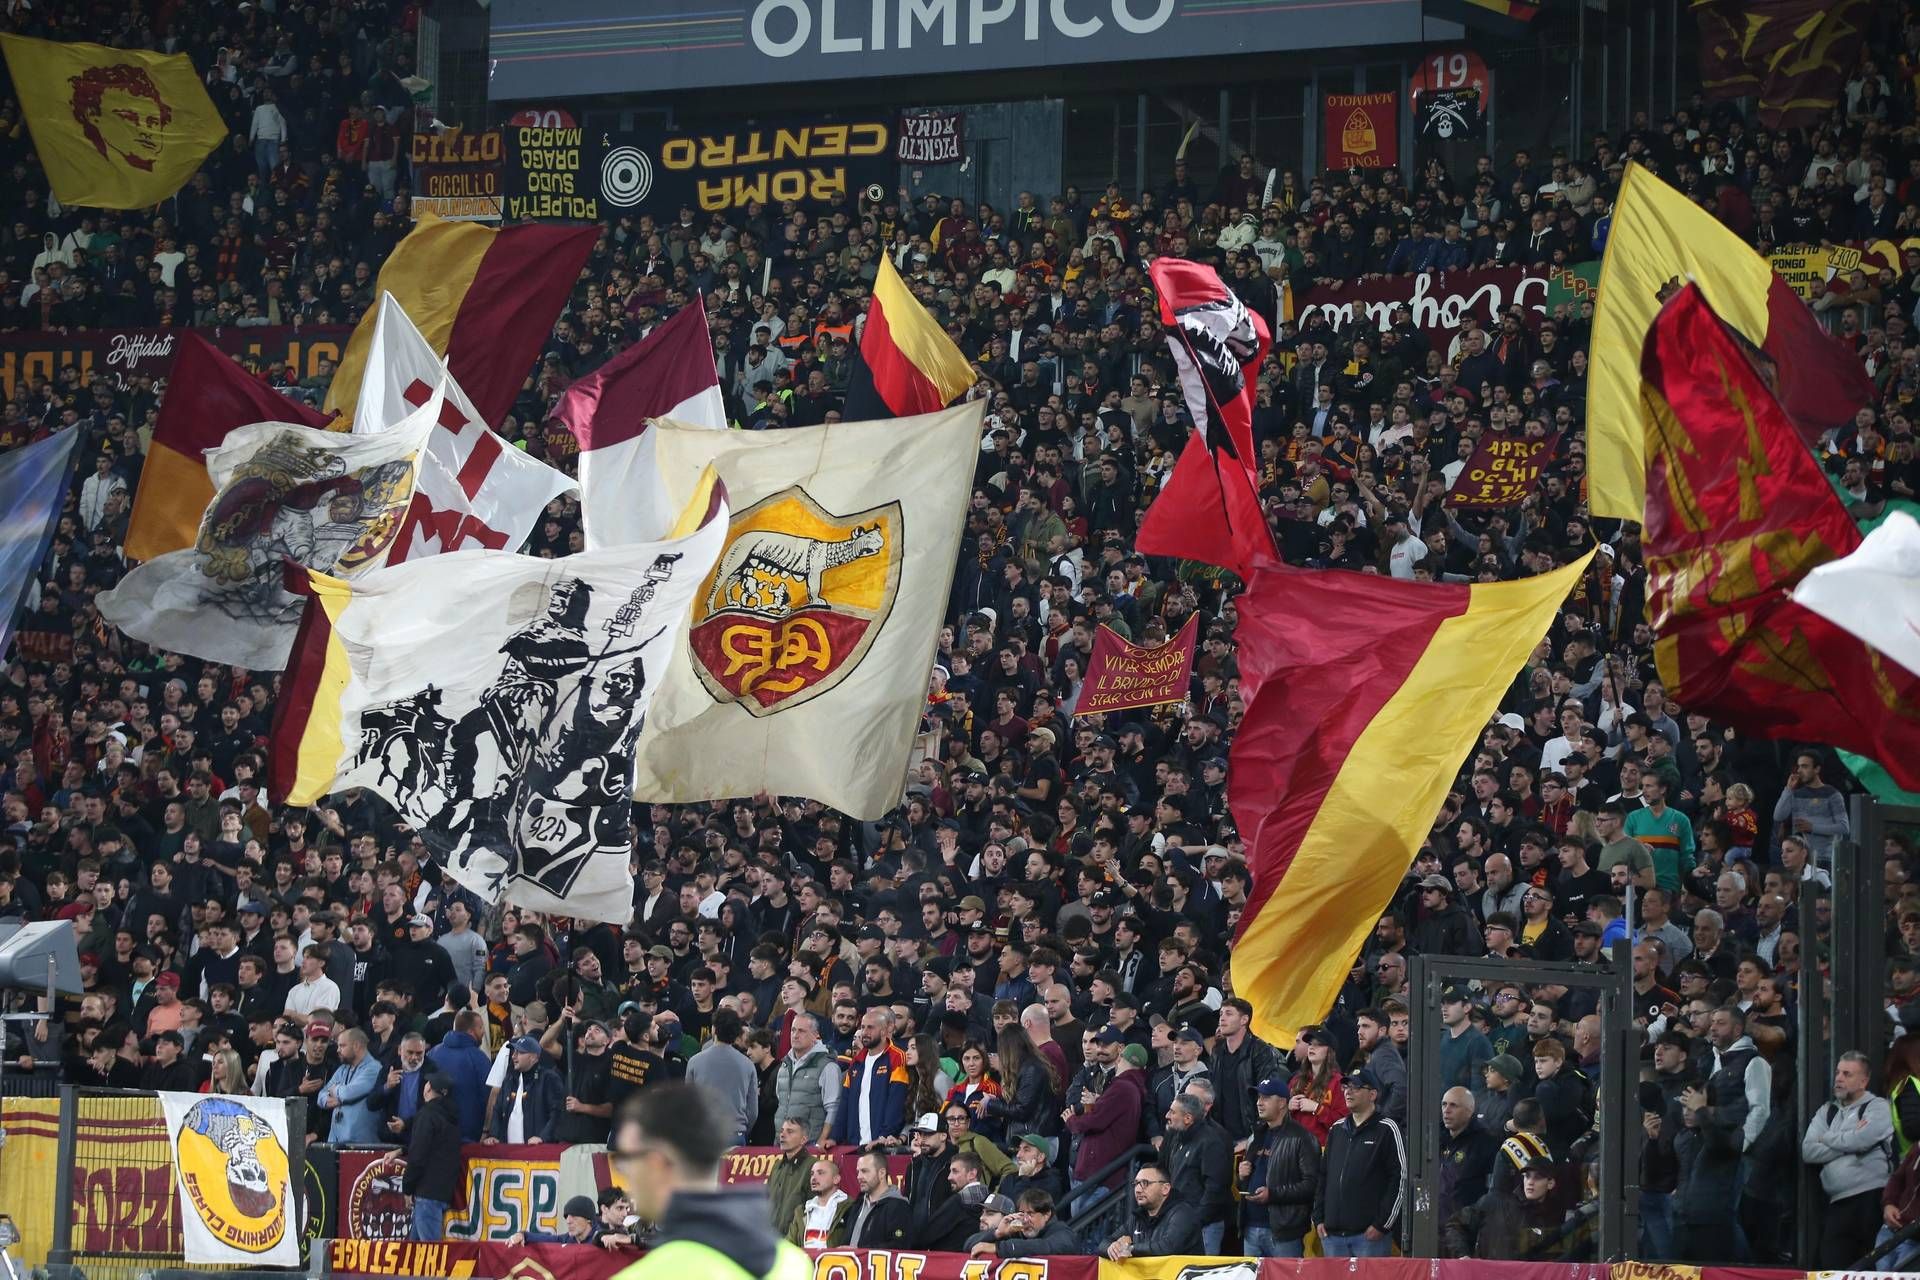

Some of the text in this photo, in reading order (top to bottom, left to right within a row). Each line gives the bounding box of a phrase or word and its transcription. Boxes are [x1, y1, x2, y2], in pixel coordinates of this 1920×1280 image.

[749, 0, 1176, 59] OLIMPICO
[1431, 54, 1467, 88] 19
[1327, 92, 1393, 107] MAMMOLO
[519, 127, 583, 147] MARCO
[905, 117, 956, 137] ROMA
[520, 149, 580, 170] DRAGO
[661, 123, 888, 170] CENTRO
[898, 134, 959, 161] PIGNETO
[1342, 155, 1381, 168] PONTE
[429, 173, 495, 197] CICCILLO
[528, 171, 575, 194] SUDO
[697, 167, 847, 212] ROMA
[509, 195, 598, 219] POLPETTA
[1772, 259, 1806, 271] PONGO
[106, 333, 175, 369] Diffidati
[1141, 647, 1187, 674] SEMPRE
[185, 1173, 226, 1232] CLASS
[352, 1163, 385, 1239] ENTILUOMINI
[225, 1217, 281, 1247] WORKING
